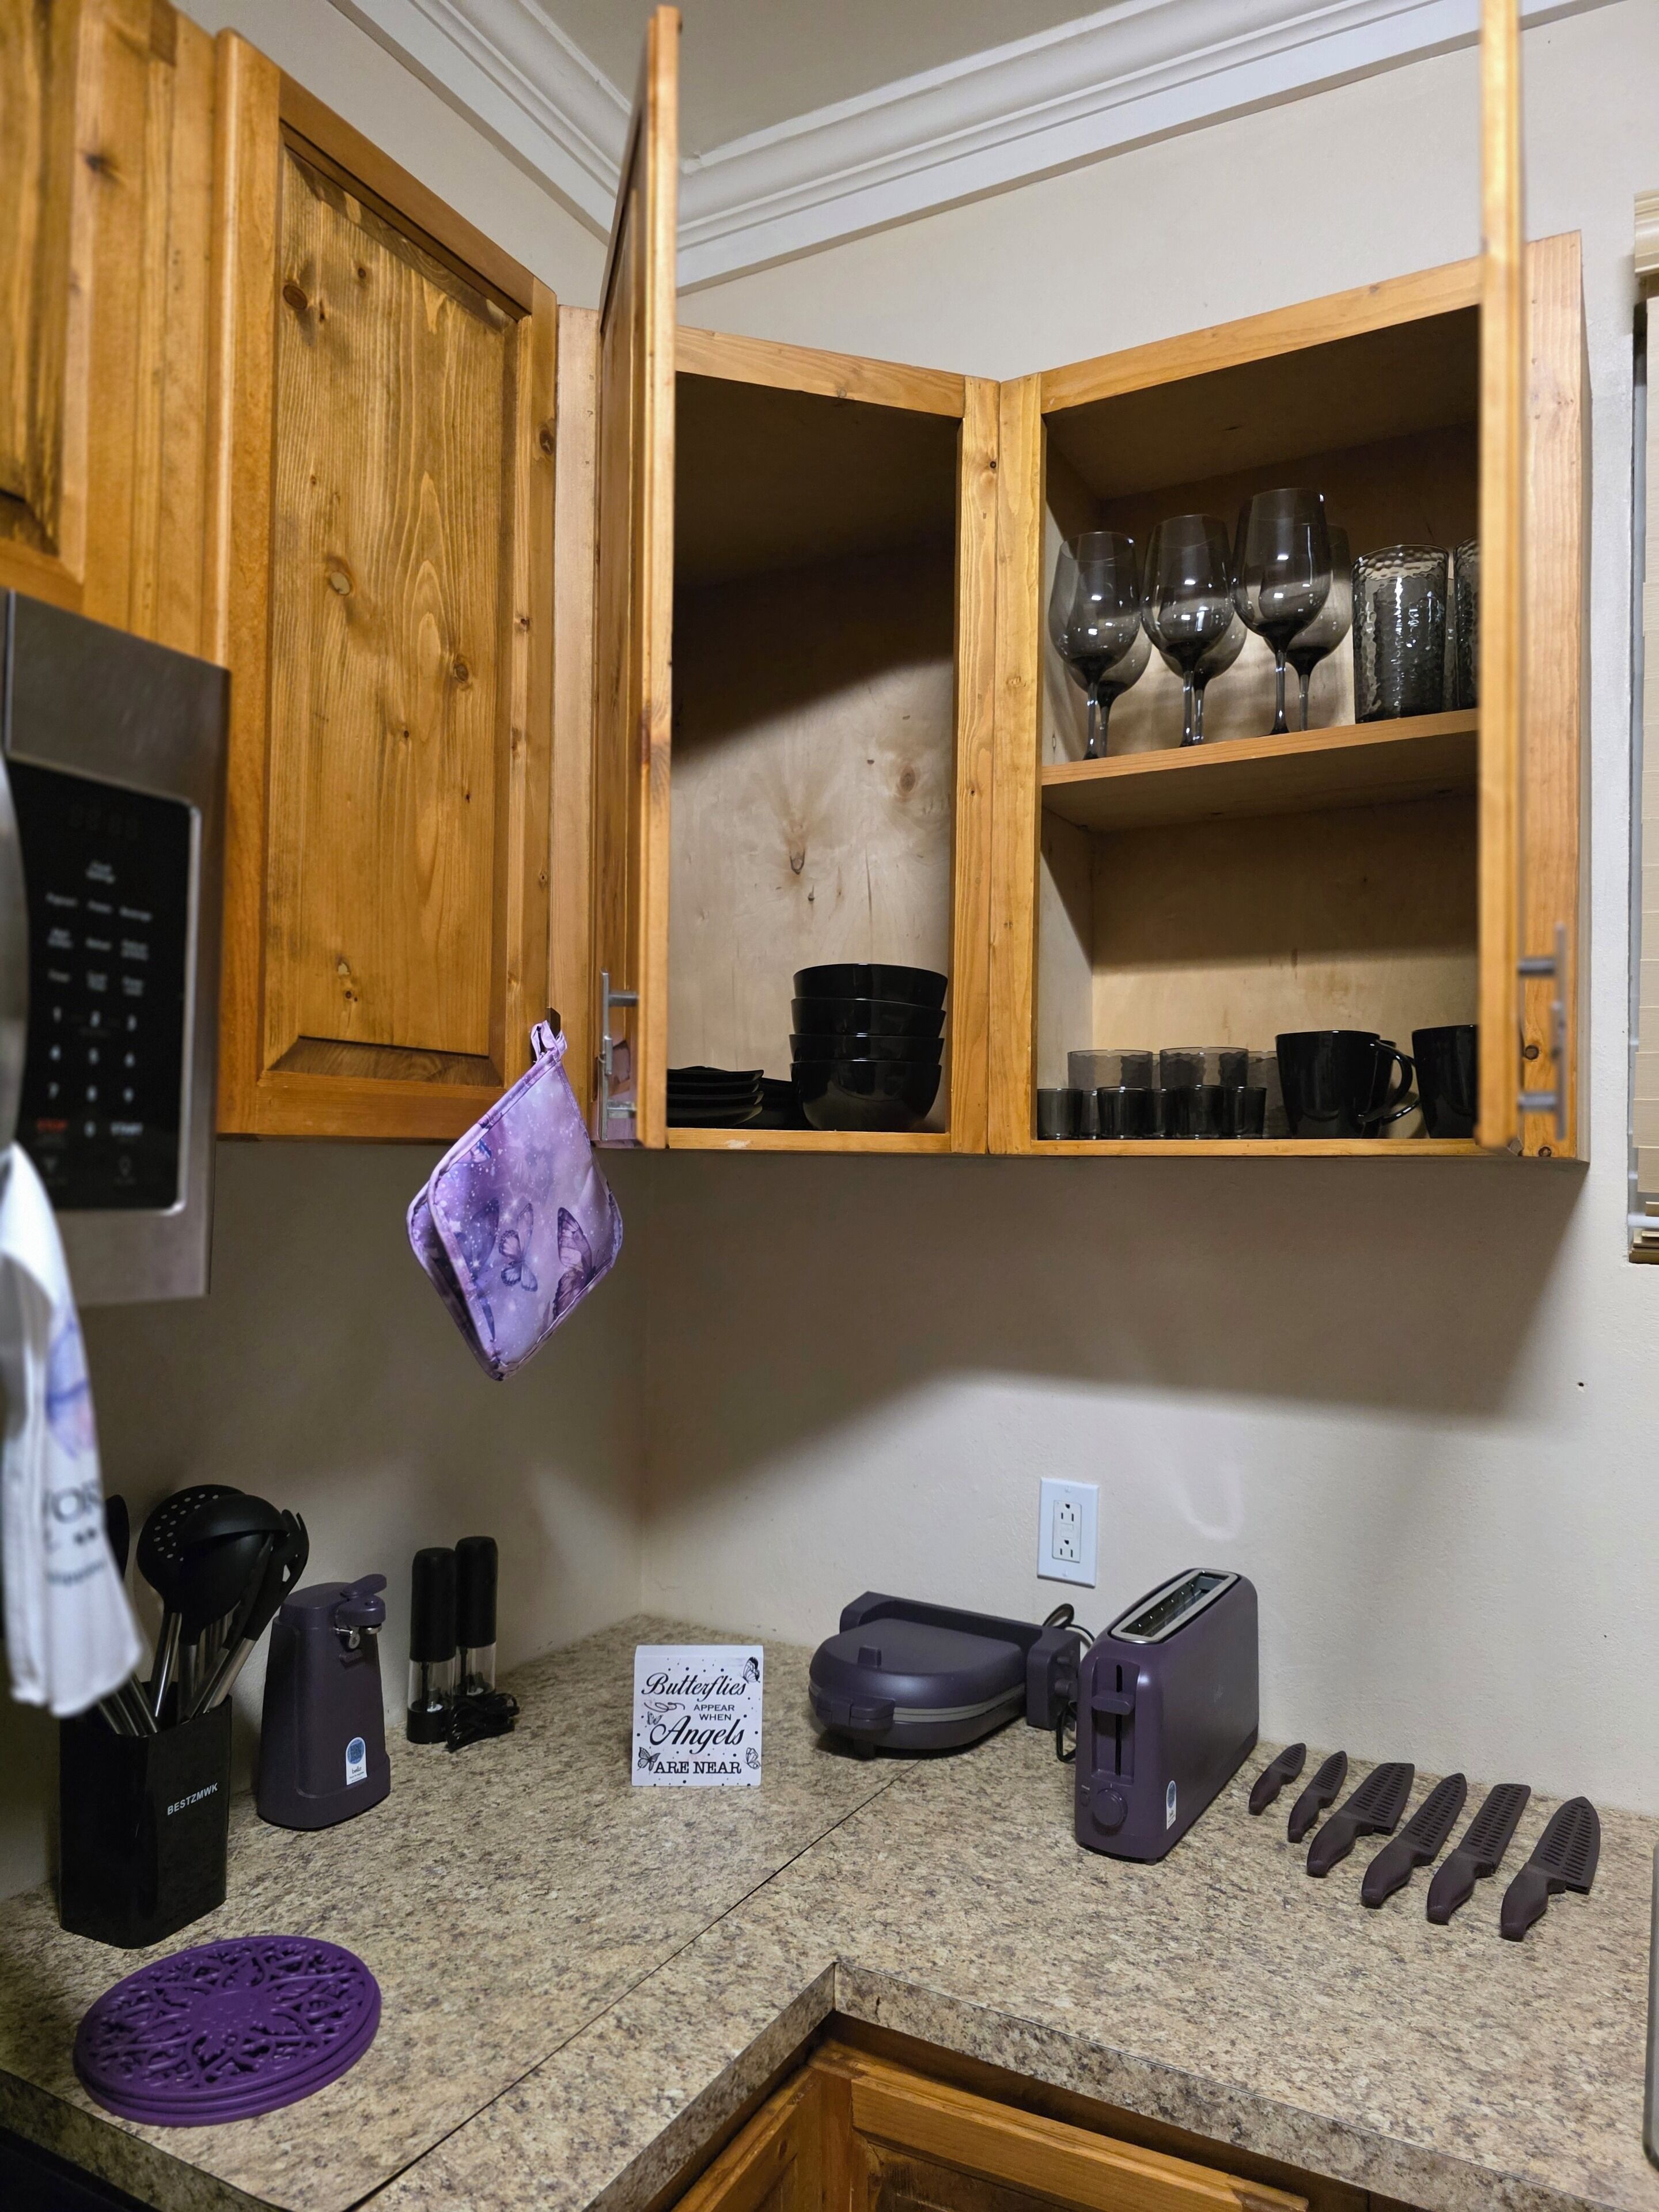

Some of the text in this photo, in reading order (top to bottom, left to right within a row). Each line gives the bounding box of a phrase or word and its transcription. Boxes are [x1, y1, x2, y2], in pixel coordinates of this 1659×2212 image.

[641, 1672, 747, 1702] Butterflies
[649, 1715, 745, 1755] Angels
[653, 1761, 741, 1774] ARE NEAR
[167, 1782, 218, 1816] BESTZMWK
